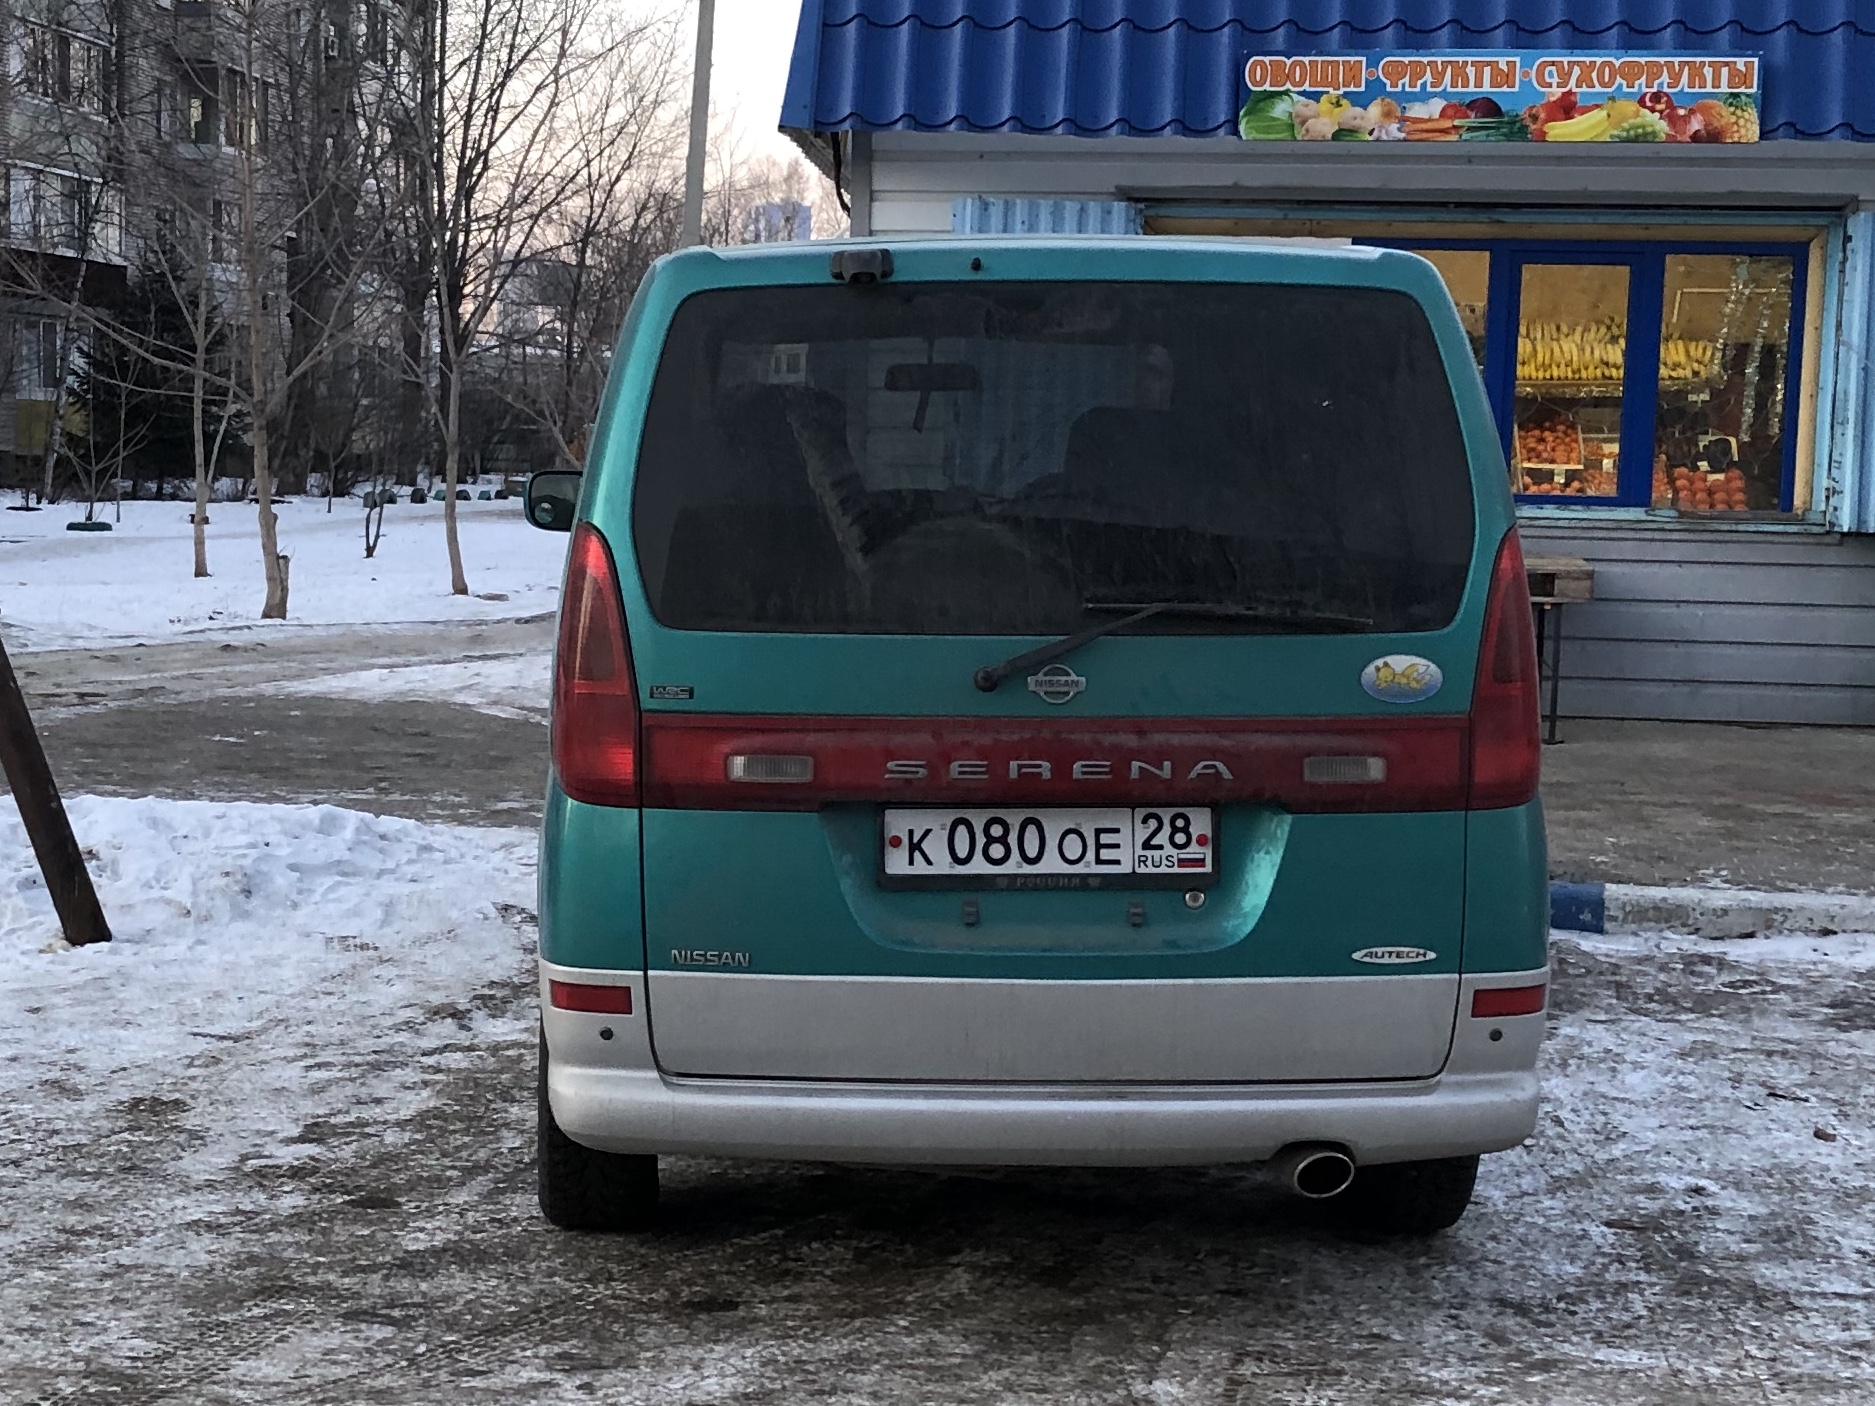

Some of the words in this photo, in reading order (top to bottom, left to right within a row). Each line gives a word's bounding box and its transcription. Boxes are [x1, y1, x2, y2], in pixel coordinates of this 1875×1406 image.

[1247, 58, 1365, 93] ОВОЩИ
[1381, 58, 1520, 92] ФРУКТЫ
[1533, 58, 1756, 92] СУХОФРУКТЫ
[1034, 679, 1080, 688] NISSAN
[884, 760, 1234, 780] SERENA
[1140, 812, 1193, 851] 28
[1137, 855, 1176, 869] RUS
[671, 949, 749, 967] NISSAN
[1360, 950, 1427, 959] AUTECH
